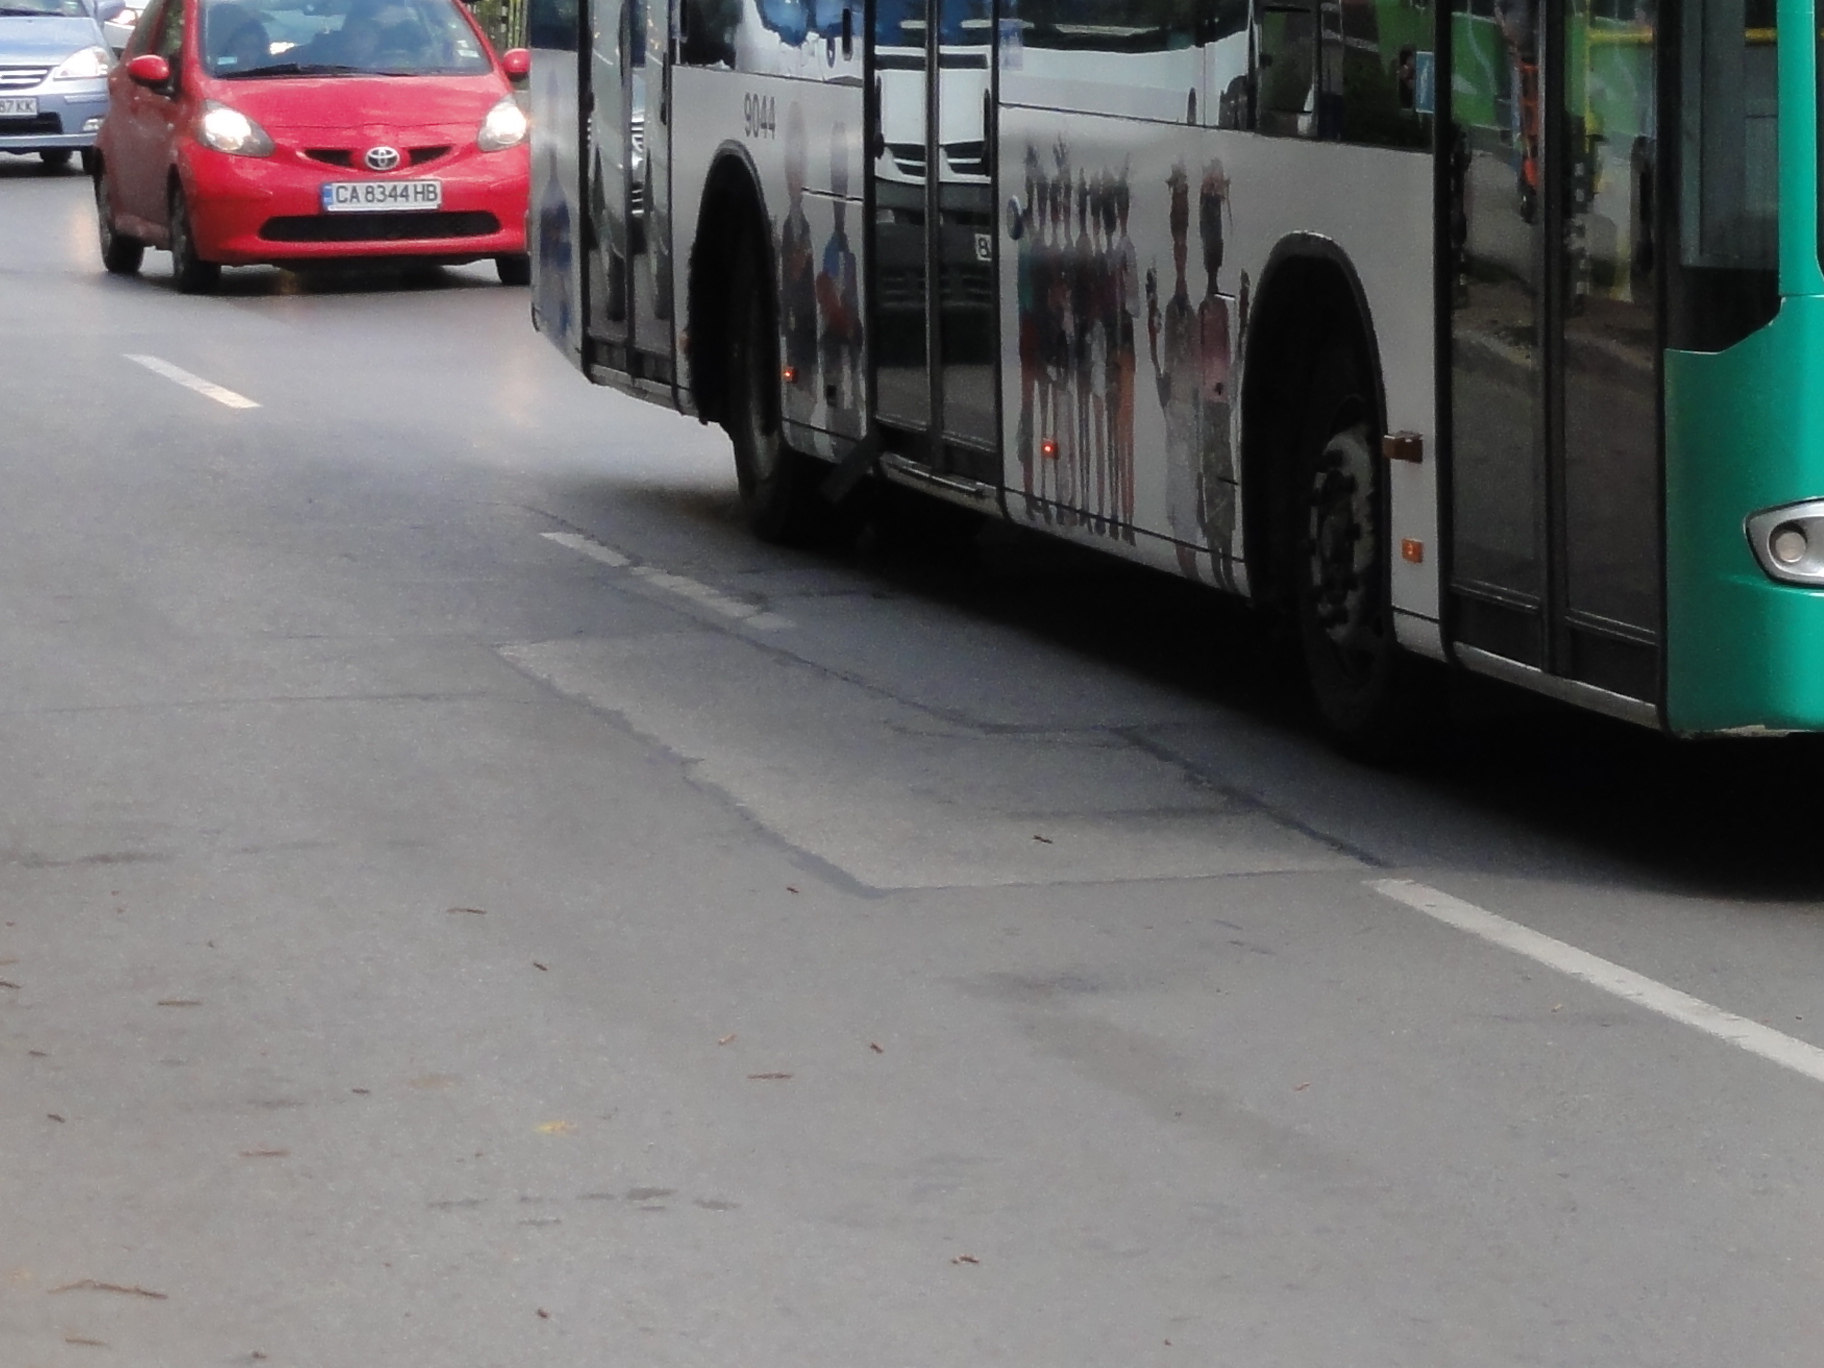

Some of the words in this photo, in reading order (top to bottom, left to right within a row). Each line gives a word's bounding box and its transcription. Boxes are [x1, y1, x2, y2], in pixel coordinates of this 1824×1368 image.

[744, 92, 775, 140] 9044
[335, 185, 360, 204] CA
[364, 184, 409, 203] 8344
[413, 183, 438, 202] HB
